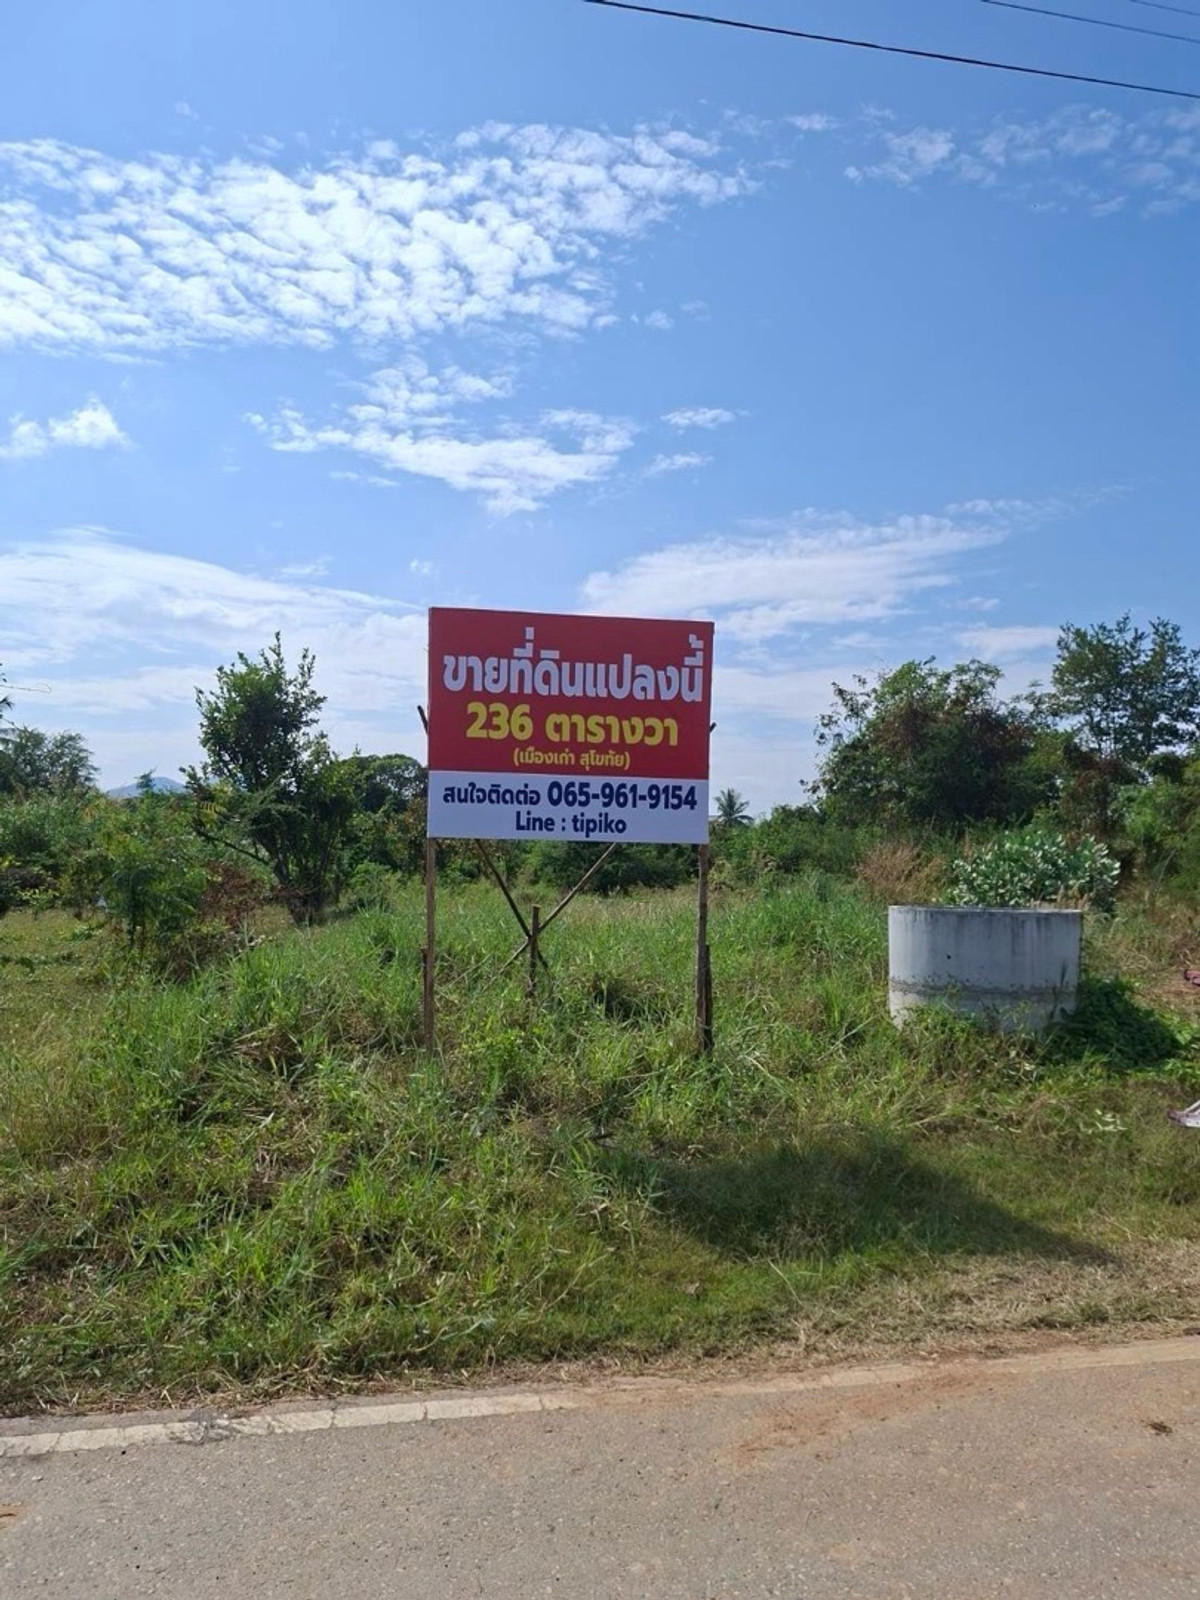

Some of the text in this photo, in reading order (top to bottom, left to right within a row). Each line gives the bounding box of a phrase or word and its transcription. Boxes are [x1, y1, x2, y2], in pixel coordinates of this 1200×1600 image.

[443, 627, 704, 702] ขายที่ดินแปลงนี้
[466, 702, 679, 746] 236 ตารางวา
[513, 747, 575, 766] (เมืองเก่า
[442, 781, 697, 810] สนใจติดต่อ 065-961-9154
[515, 811, 555, 832] Line
[572, 812, 627, 838] tipiko
